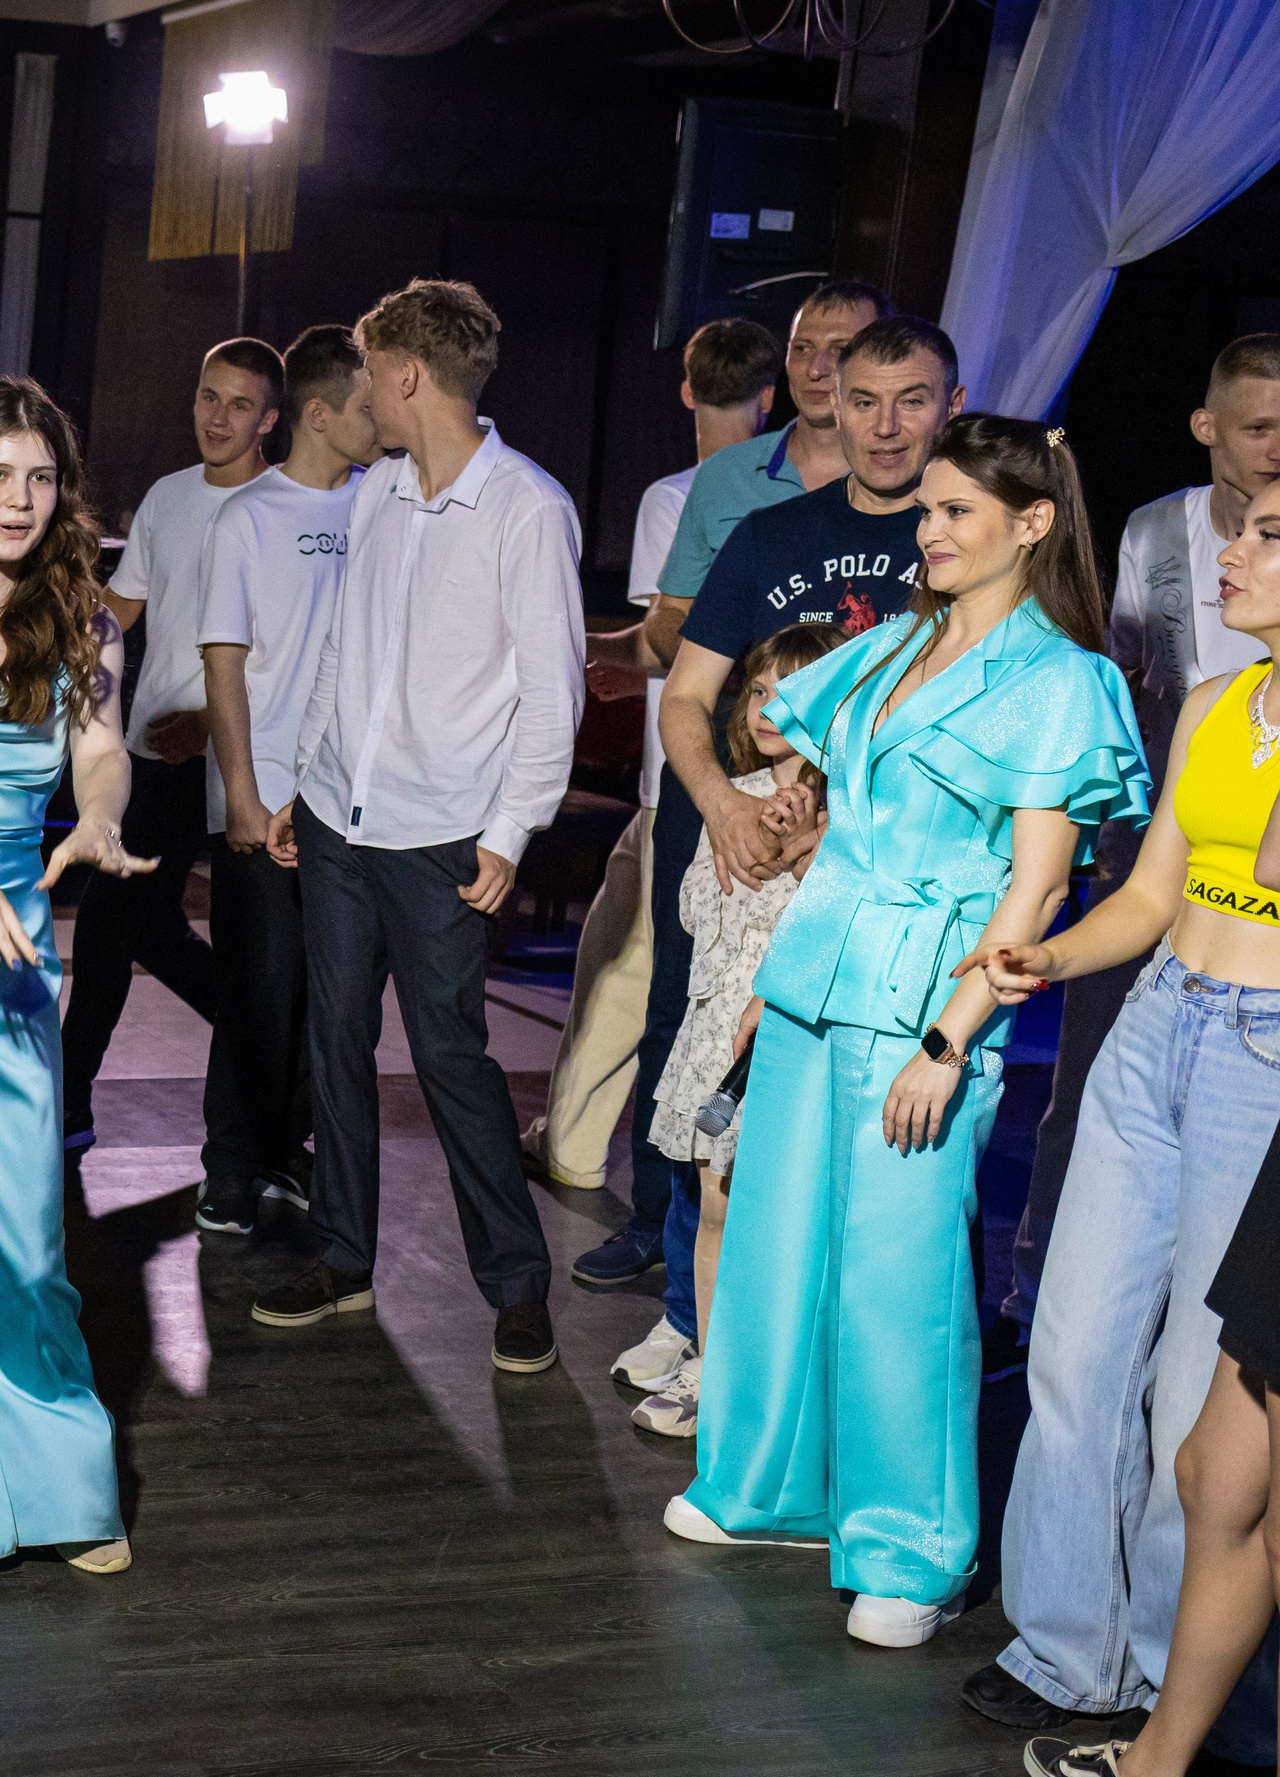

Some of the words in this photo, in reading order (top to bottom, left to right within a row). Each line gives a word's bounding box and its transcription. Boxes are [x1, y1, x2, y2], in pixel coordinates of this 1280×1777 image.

[767, 573, 813, 610] U.S.
[823, 553, 891, 582] POLO
[799, 611, 834, 623] SINCE
[1186, 878, 1280, 921] SAGAZA
